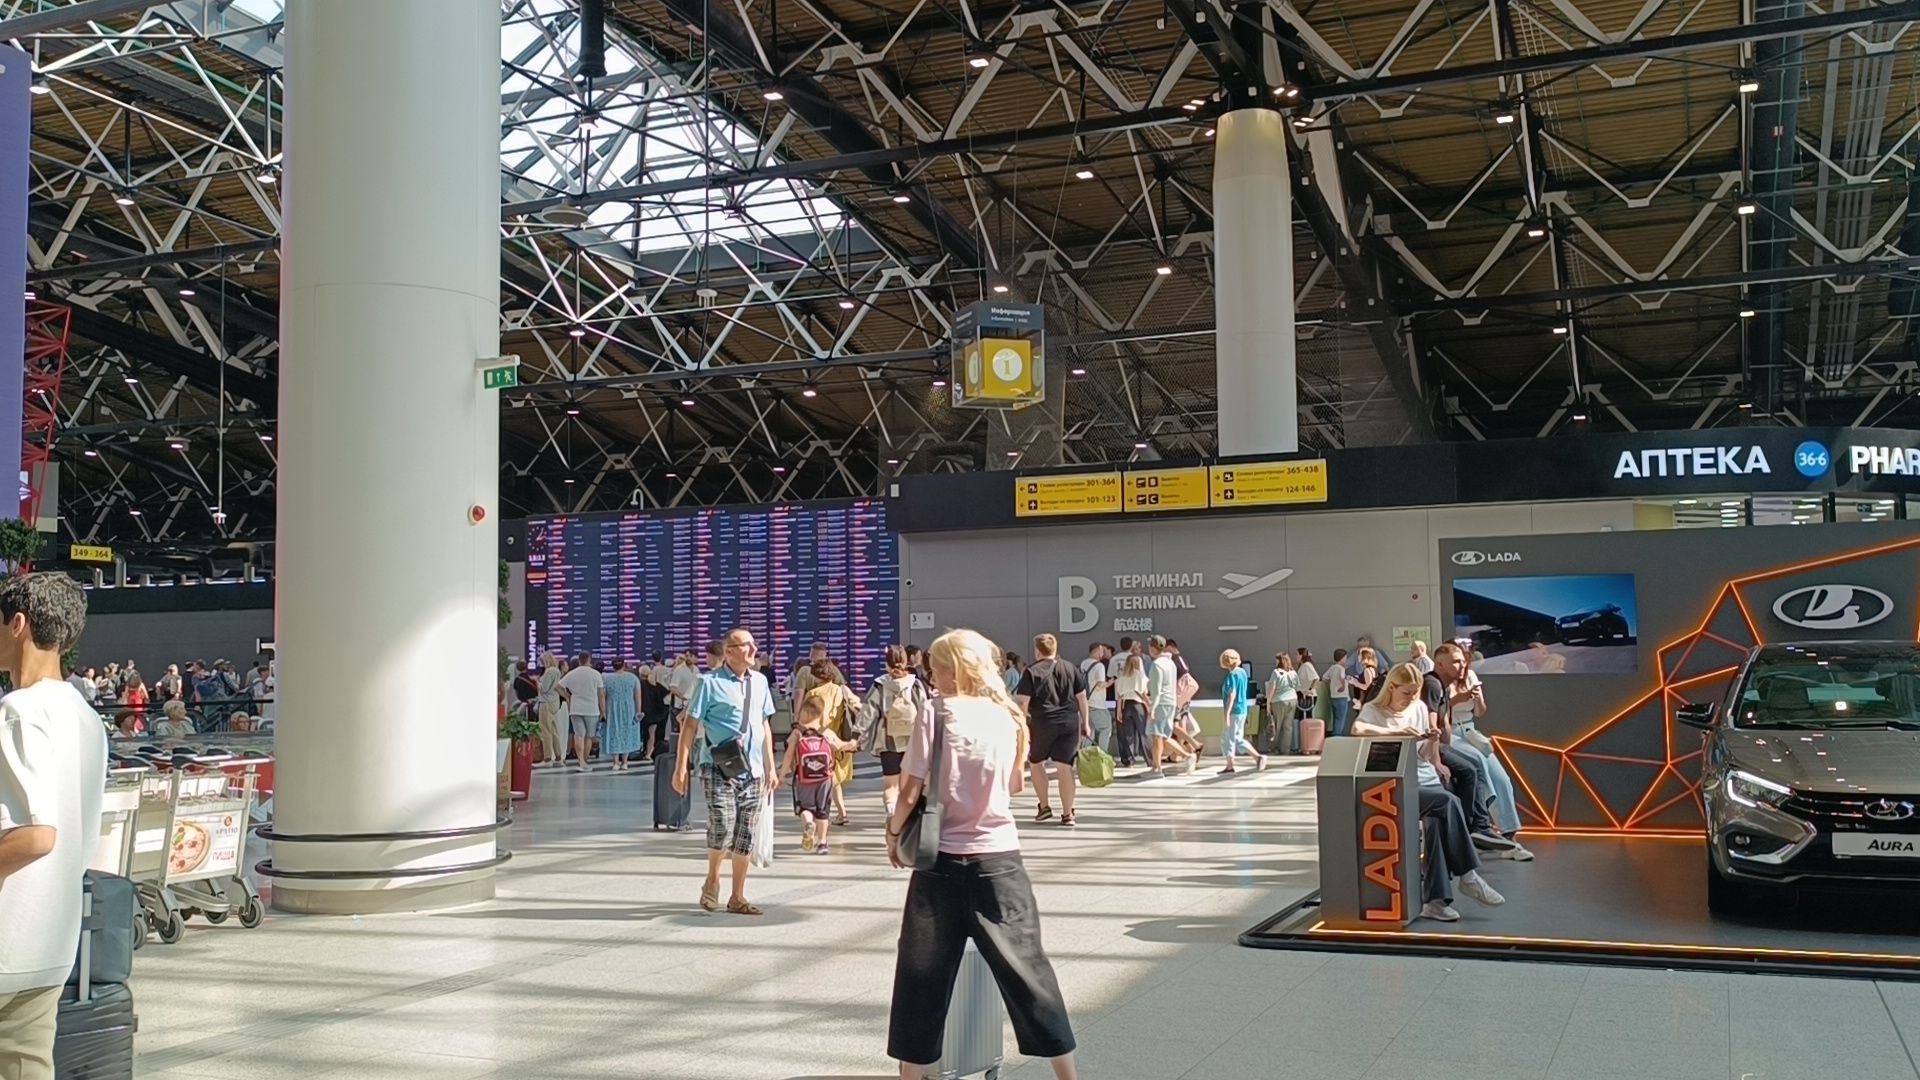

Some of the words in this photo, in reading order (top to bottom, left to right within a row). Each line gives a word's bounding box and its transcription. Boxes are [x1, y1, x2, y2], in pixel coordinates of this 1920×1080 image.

[1613, 445, 1772, 479] АПТЕКА
[1287, 465, 1319, 475] 365-438
[1086, 478, 1115, 487] 301-364
[1286, 485, 1316, 494] 124-146
[1086, 495, 1115, 504] 101-123
[1487, 552, 1521, 562] LADA
[1112, 572, 1204, 589] ТЕРМИНАЛ
[1058, 575, 1100, 633] B
[1112, 595, 1196, 610] TERMINAL
[1361, 778, 1402, 921] LADA
[1867, 839, 1914, 852] AURA
